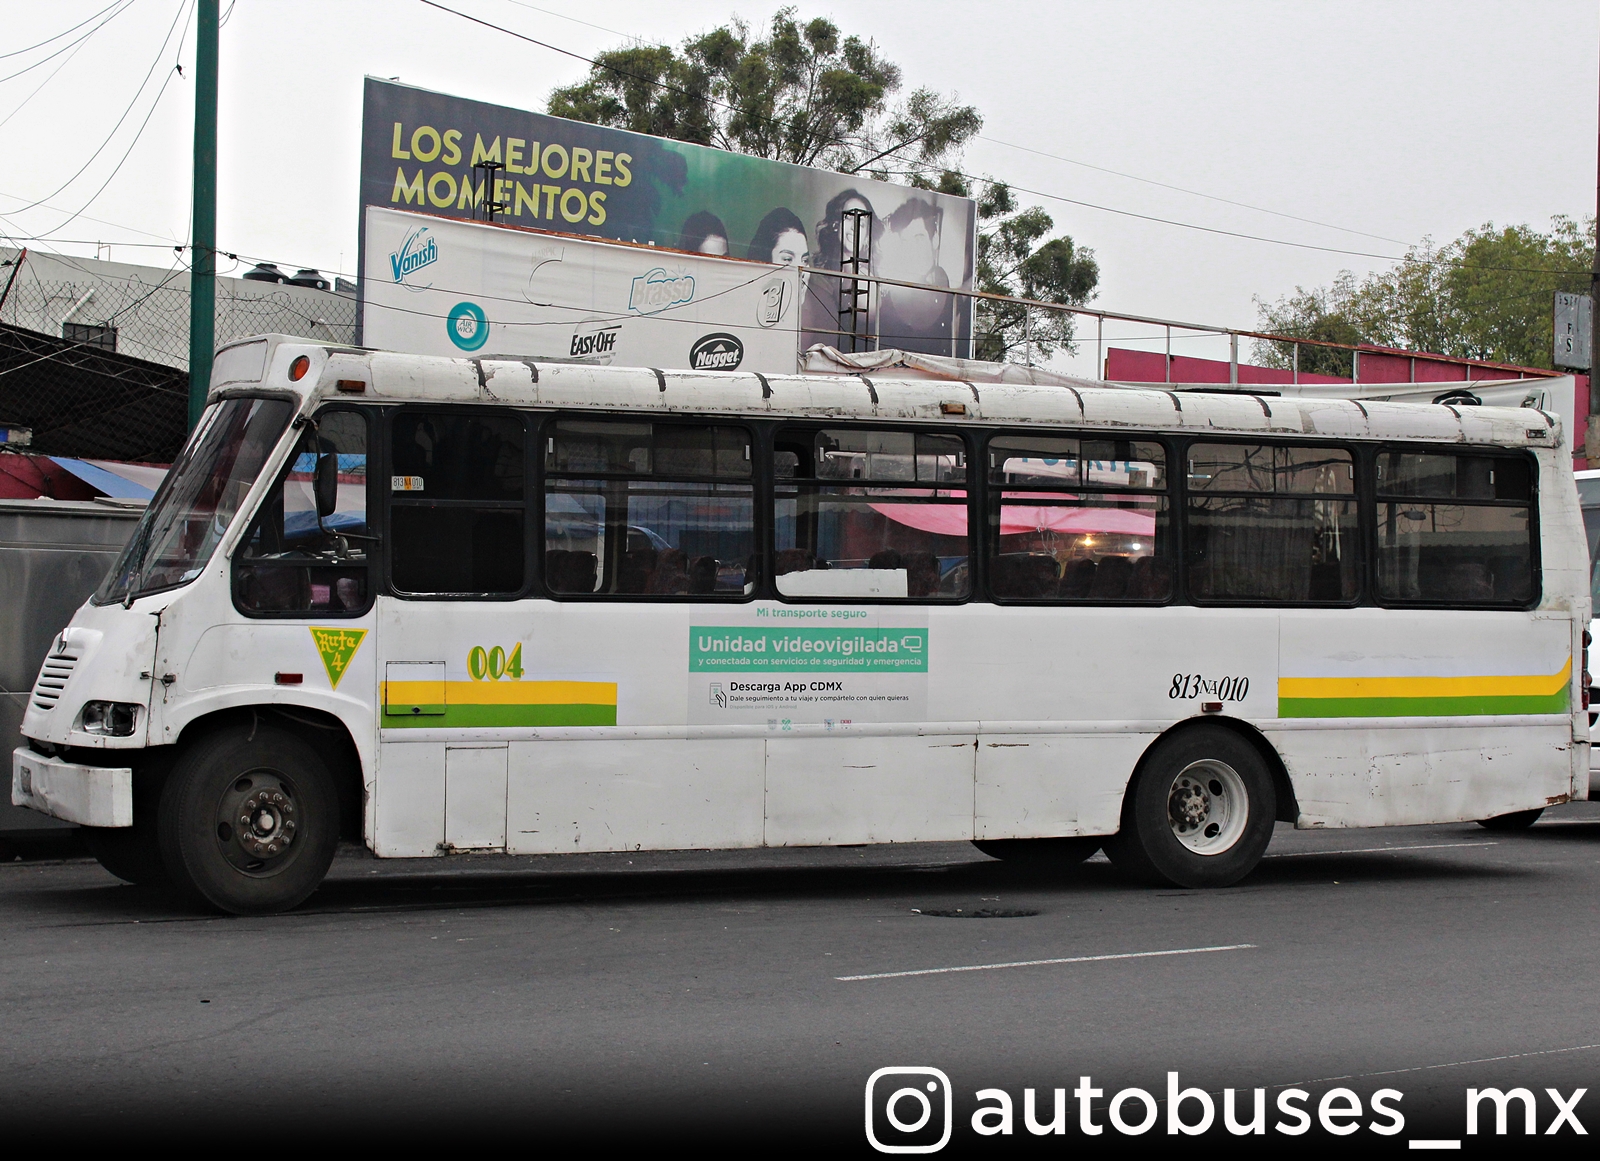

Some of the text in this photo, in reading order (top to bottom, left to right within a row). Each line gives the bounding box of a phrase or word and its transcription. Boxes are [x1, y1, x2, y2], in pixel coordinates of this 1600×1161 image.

[392, 122, 633, 188] LOS MEJORES
[391, 166, 608, 226] MOMENTOS
[390, 237, 437, 281] Vanish
[633, 280, 692, 306] Brasso
[457, 326, 474, 334] WICK
[459, 320, 472, 328] AIR
[696, 349, 738, 367] Nugget
[756, 608, 867, 619] Mi transporte seguro
[316, 631, 357, 653] Ruta
[698, 636, 898, 655] Unidad videovigilada
[331, 652, 344, 672] 4
[467, 642, 525, 682] 004
[706, 657, 750, 665] conectada
[771, 657, 807, 665] servicios
[810, 657, 821, 665] de
[823, 658, 864, 667] seguridad
[874, 658, 921, 667] emergencia
[730, 682, 842, 693] Descarga App CDMX
[745, 695, 783, 703] seguimiento
[799, 695, 813, 703] viaje
[820, 694, 855, 702] compártelo
